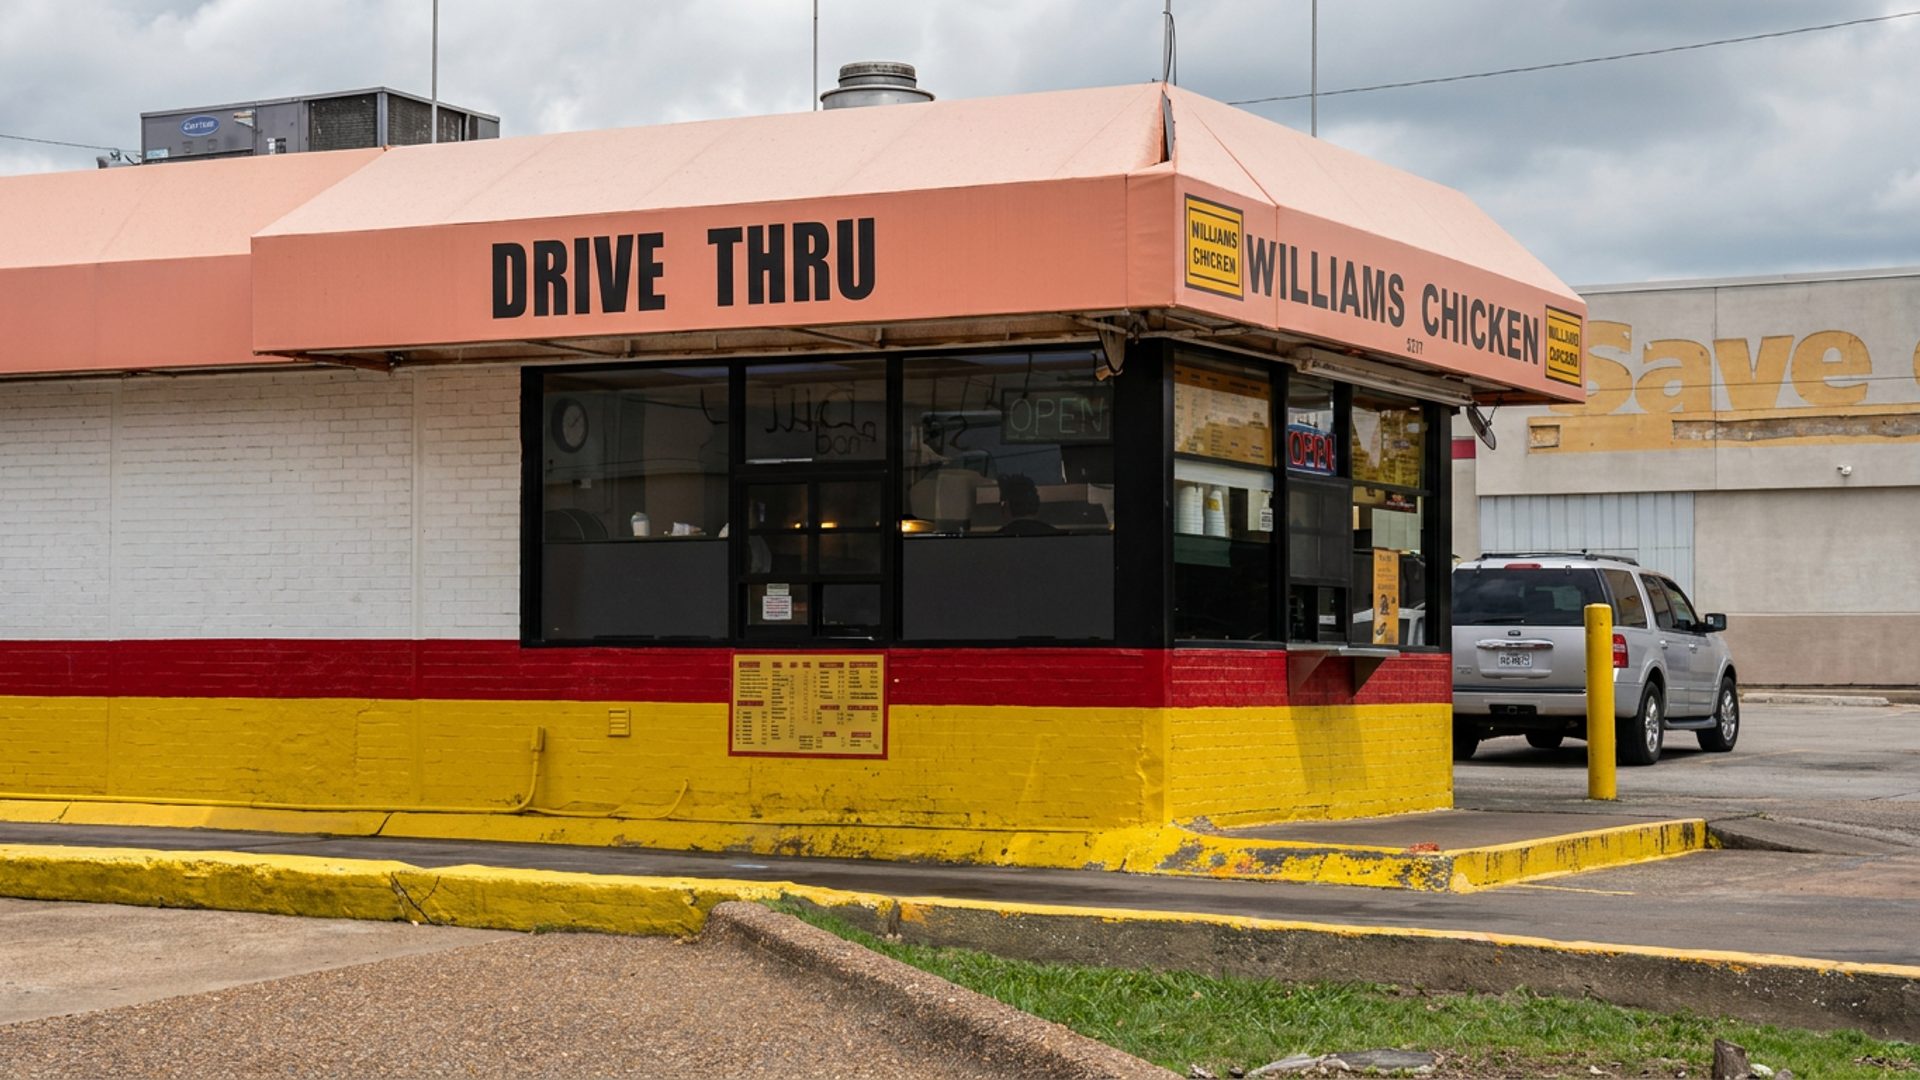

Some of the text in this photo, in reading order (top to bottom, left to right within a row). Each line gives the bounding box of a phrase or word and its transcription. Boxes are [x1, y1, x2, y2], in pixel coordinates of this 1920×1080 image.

[491, 217, 876, 319] DRIVE THRU
[1246, 233, 1540, 366] WILLIAMS CHICKEN
[1009, 396, 1105, 437] OPEN
